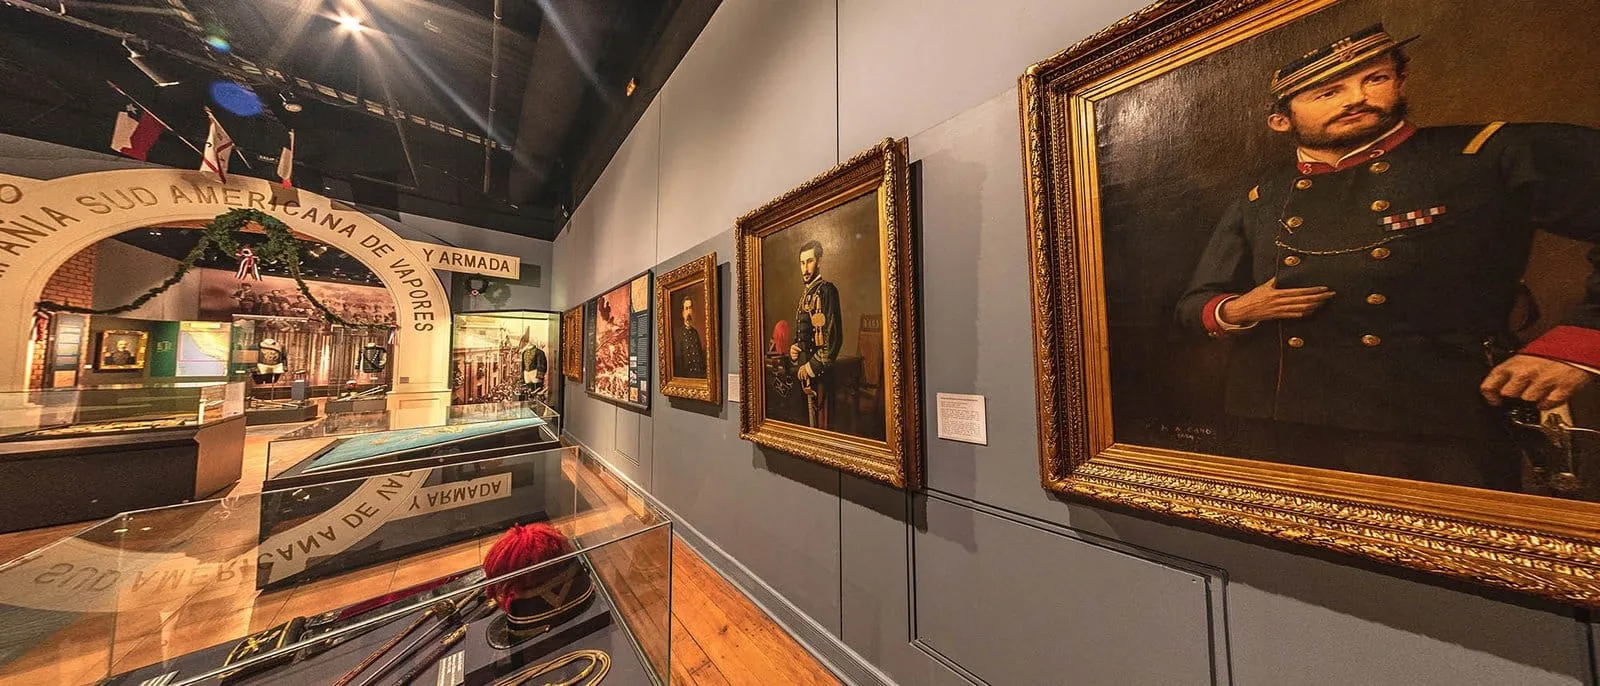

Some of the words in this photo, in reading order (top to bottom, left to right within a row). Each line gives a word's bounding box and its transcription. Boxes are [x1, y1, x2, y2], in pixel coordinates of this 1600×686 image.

[0, 206, 80, 277] AÑIA
[76, 187, 158, 214] SUD
[169, 183, 357, 238] AMERICANA
[360, 234, 395, 258] DE
[389, 258, 434, 332] VAPORES
[422, 248, 434, 262] Y
[439, 251, 510, 273] ARMADA
